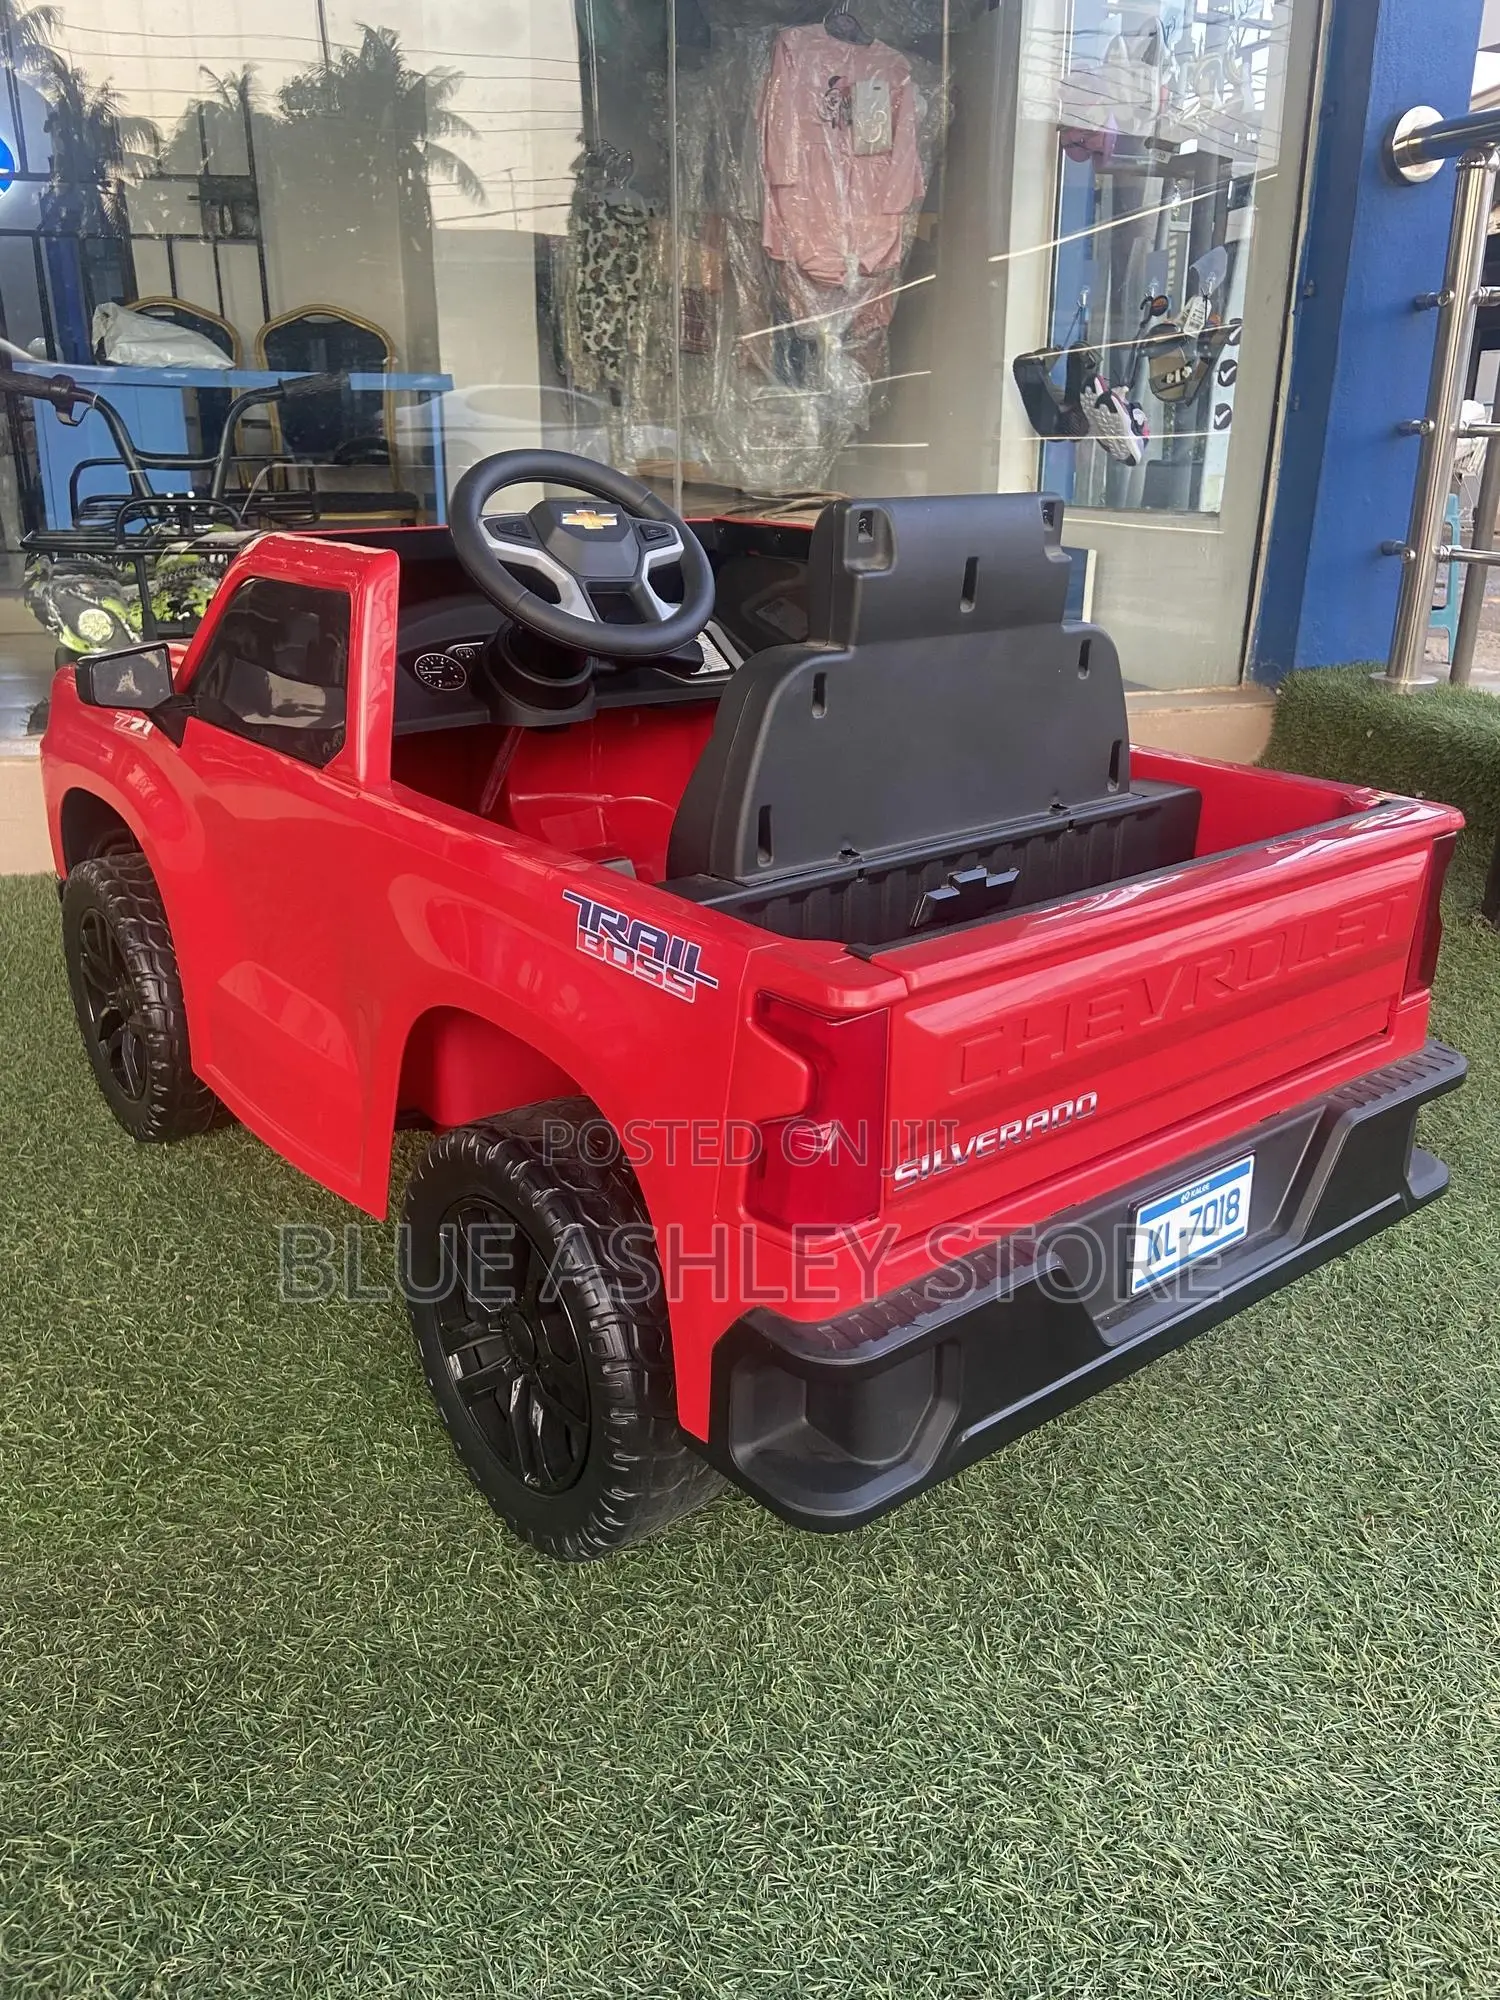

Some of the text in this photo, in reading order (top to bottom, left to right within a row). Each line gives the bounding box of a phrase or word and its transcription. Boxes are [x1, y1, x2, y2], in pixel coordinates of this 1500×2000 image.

[113, 711, 154, 737] Z71
[562, 889, 719, 989] TRAIL
[576, 925, 697, 1004] BOSS
[949, 890, 1408, 1095] CHEVROLET
[893, 1090, 1099, 1192] SILVERADO
[1146, 1186, 1241, 1268] KL-7018
